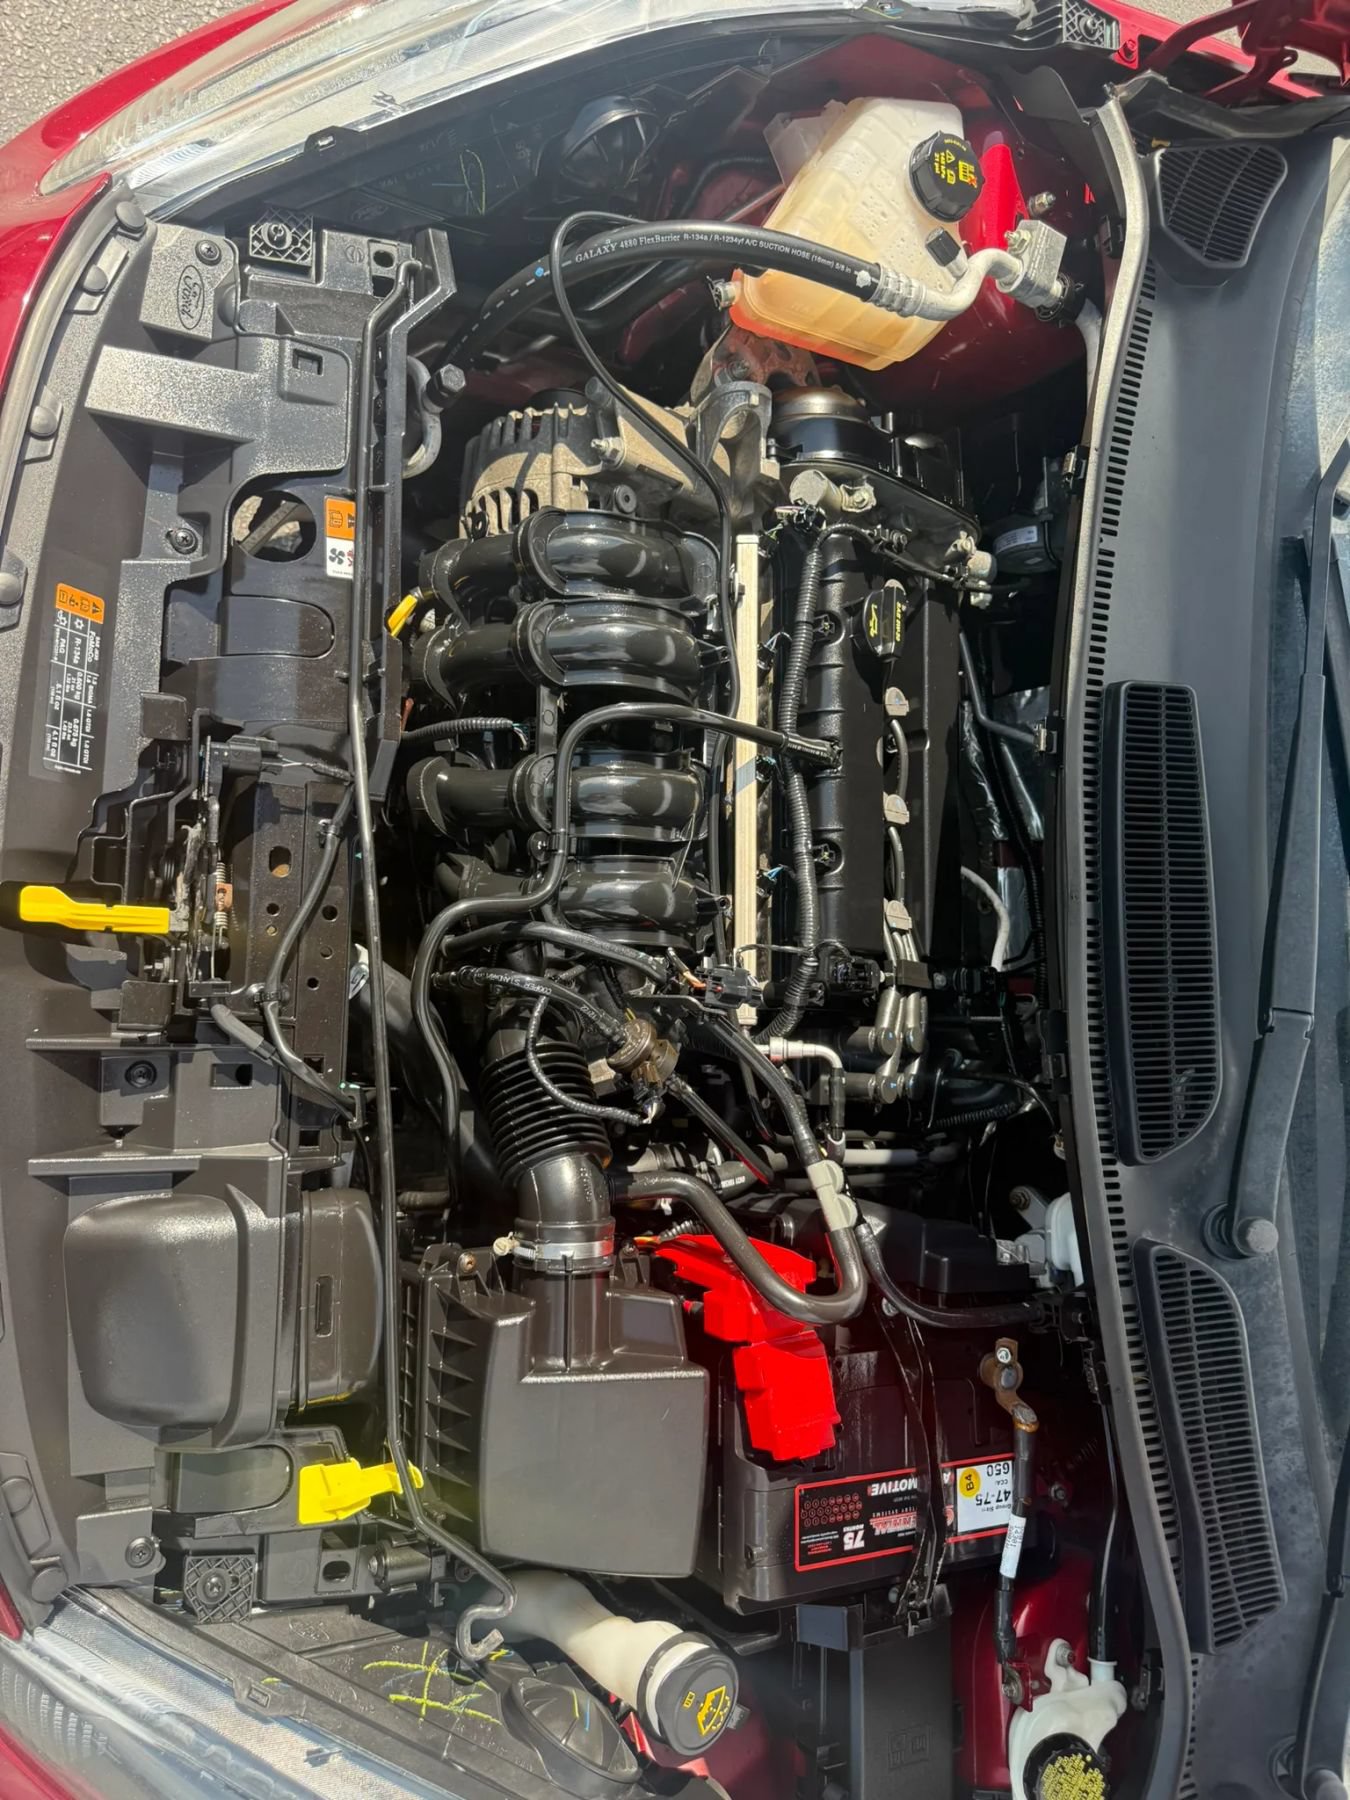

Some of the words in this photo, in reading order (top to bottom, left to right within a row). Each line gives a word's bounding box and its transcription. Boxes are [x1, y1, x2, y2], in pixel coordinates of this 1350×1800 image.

[575, 242, 618, 263] GALAXY
[639, 233, 681, 246] FlexBarrier
[683, 232, 708, 241] R-134a
[714, 234, 745, 246] R-1234yf
[744, 238, 758, 247] A/C
[758, 240, 790, 254] SUCTION
[791, 247, 811, 261] HOSE
[181, 275, 202, 319] Ford
[73, 637, 81, 665] R-134a
[87, 631, 96, 663] FoMoCo
[73, 690, 81, 701] kg
[70, 737, 78, 747] kg
[523, 982, 552, 996] COOPER
[986, 1462, 1010, 1477] 650
[975, 1488, 1011, 1506] 47-75
[842, 1529, 865, 1551] 75
